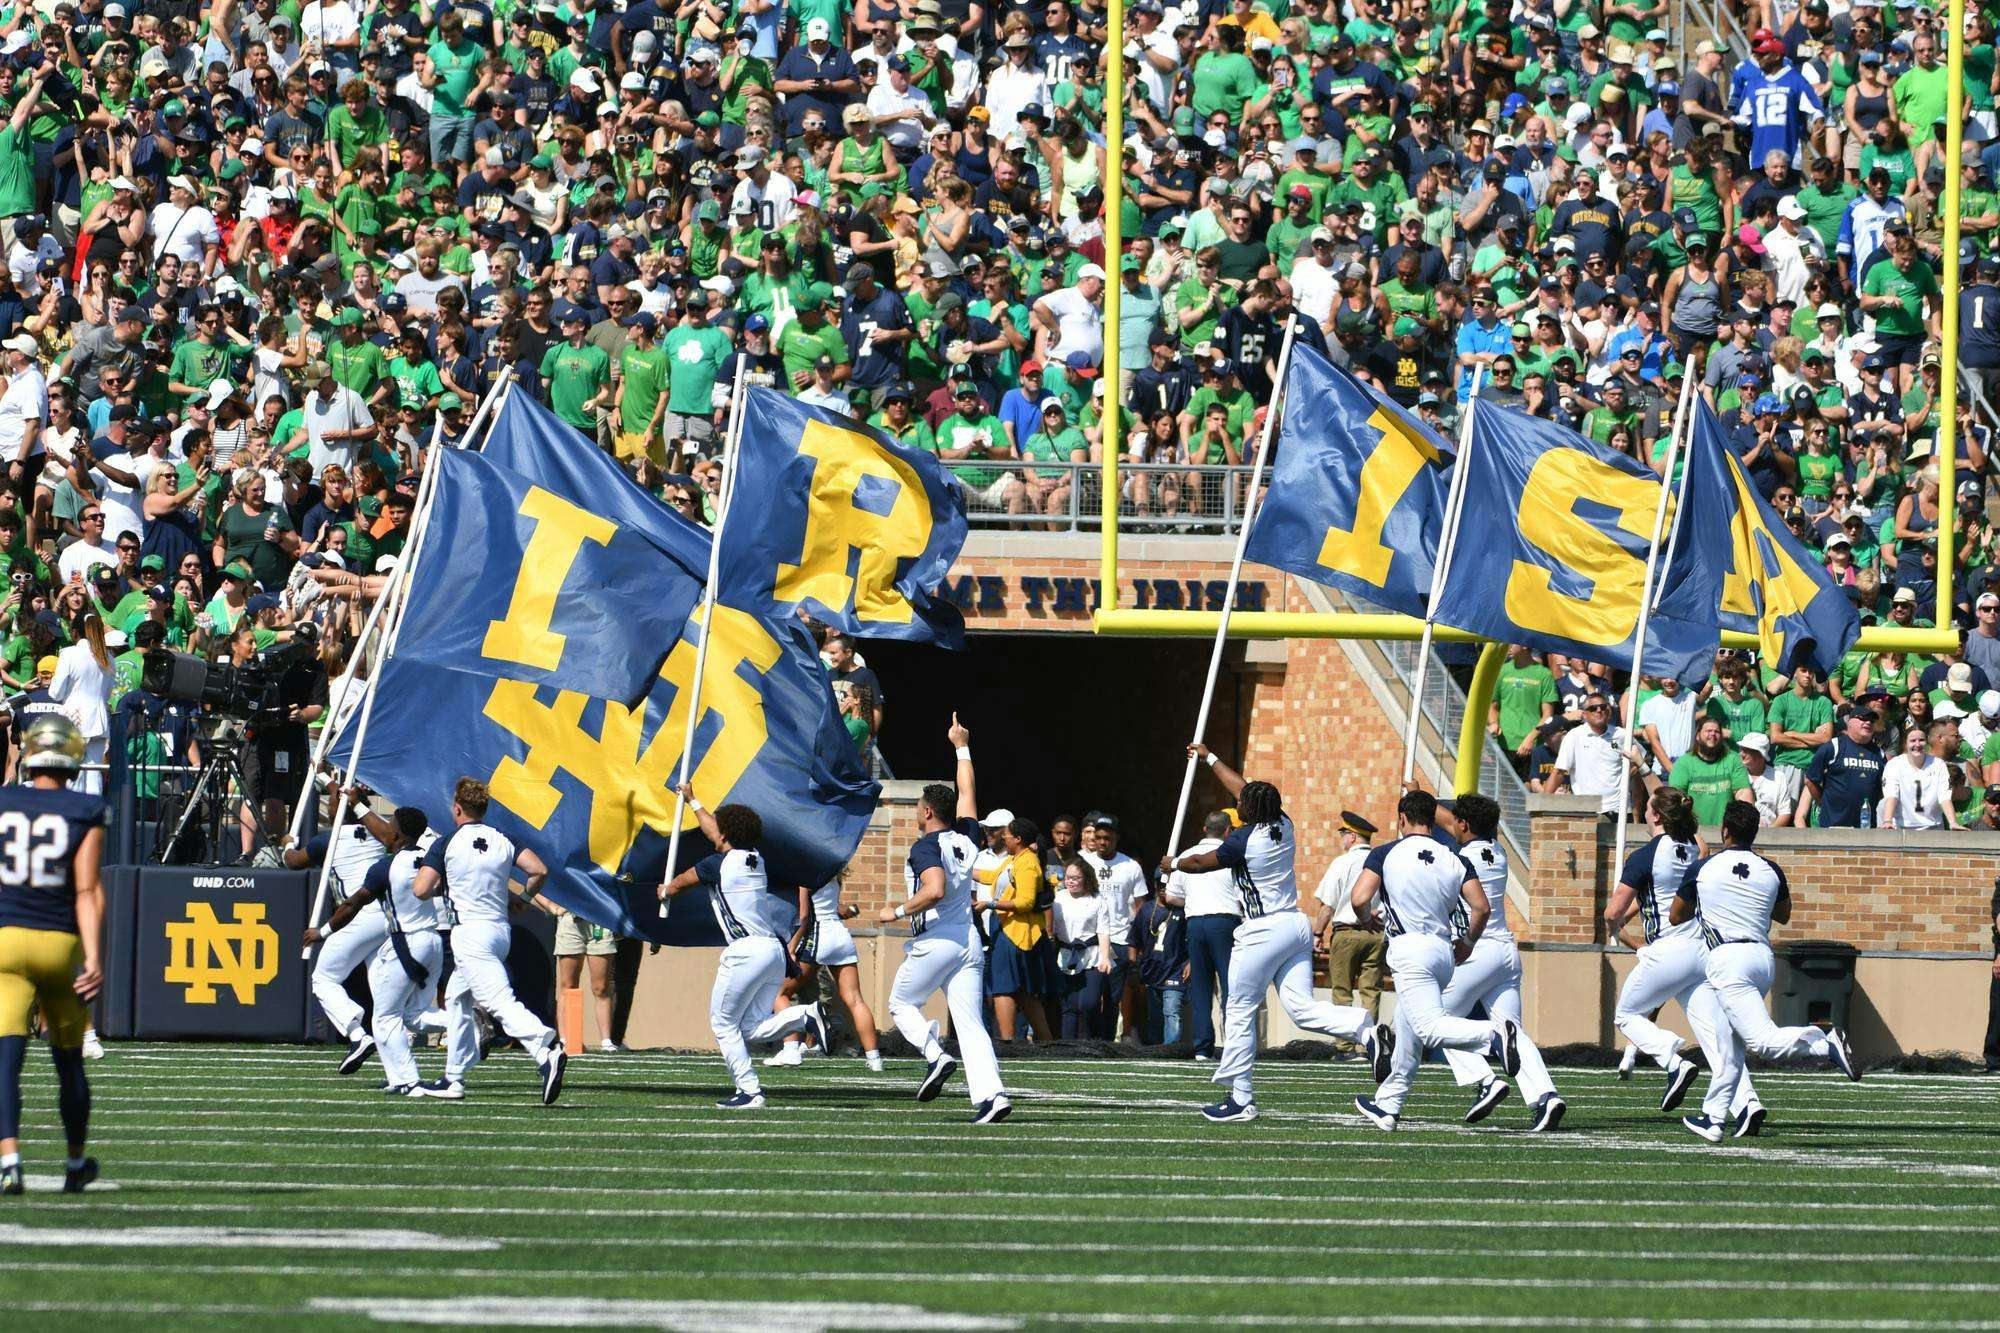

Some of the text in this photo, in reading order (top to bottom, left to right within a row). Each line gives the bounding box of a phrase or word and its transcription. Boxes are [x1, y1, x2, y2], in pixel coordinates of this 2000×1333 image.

[1755, 93, 1788, 127] 12
[1972, 296, 1984, 328] 1
[858, 321, 878, 356] 7
[1240, 334, 1265, 363] 25
[1396, 358, 1417, 376] ND
[1157, 384, 1167, 409] 1
[1317, 404, 1443, 588] I
[774, 418, 934, 623] R
[1505, 446, 1676, 646] S
[481, 485, 619, 672] I
[1133, 579, 1266, 611] IRISH
[1843, 757, 1880, 770] IRISH
[1914, 779, 1925, 813] 1
[0, 811, 69, 887] 32
[192, 876, 255, 889] UND.COM
[1098, 866, 1113, 880] ND
[1153, 920, 1168, 952] 1
[164, 902, 279, 1005] ND
